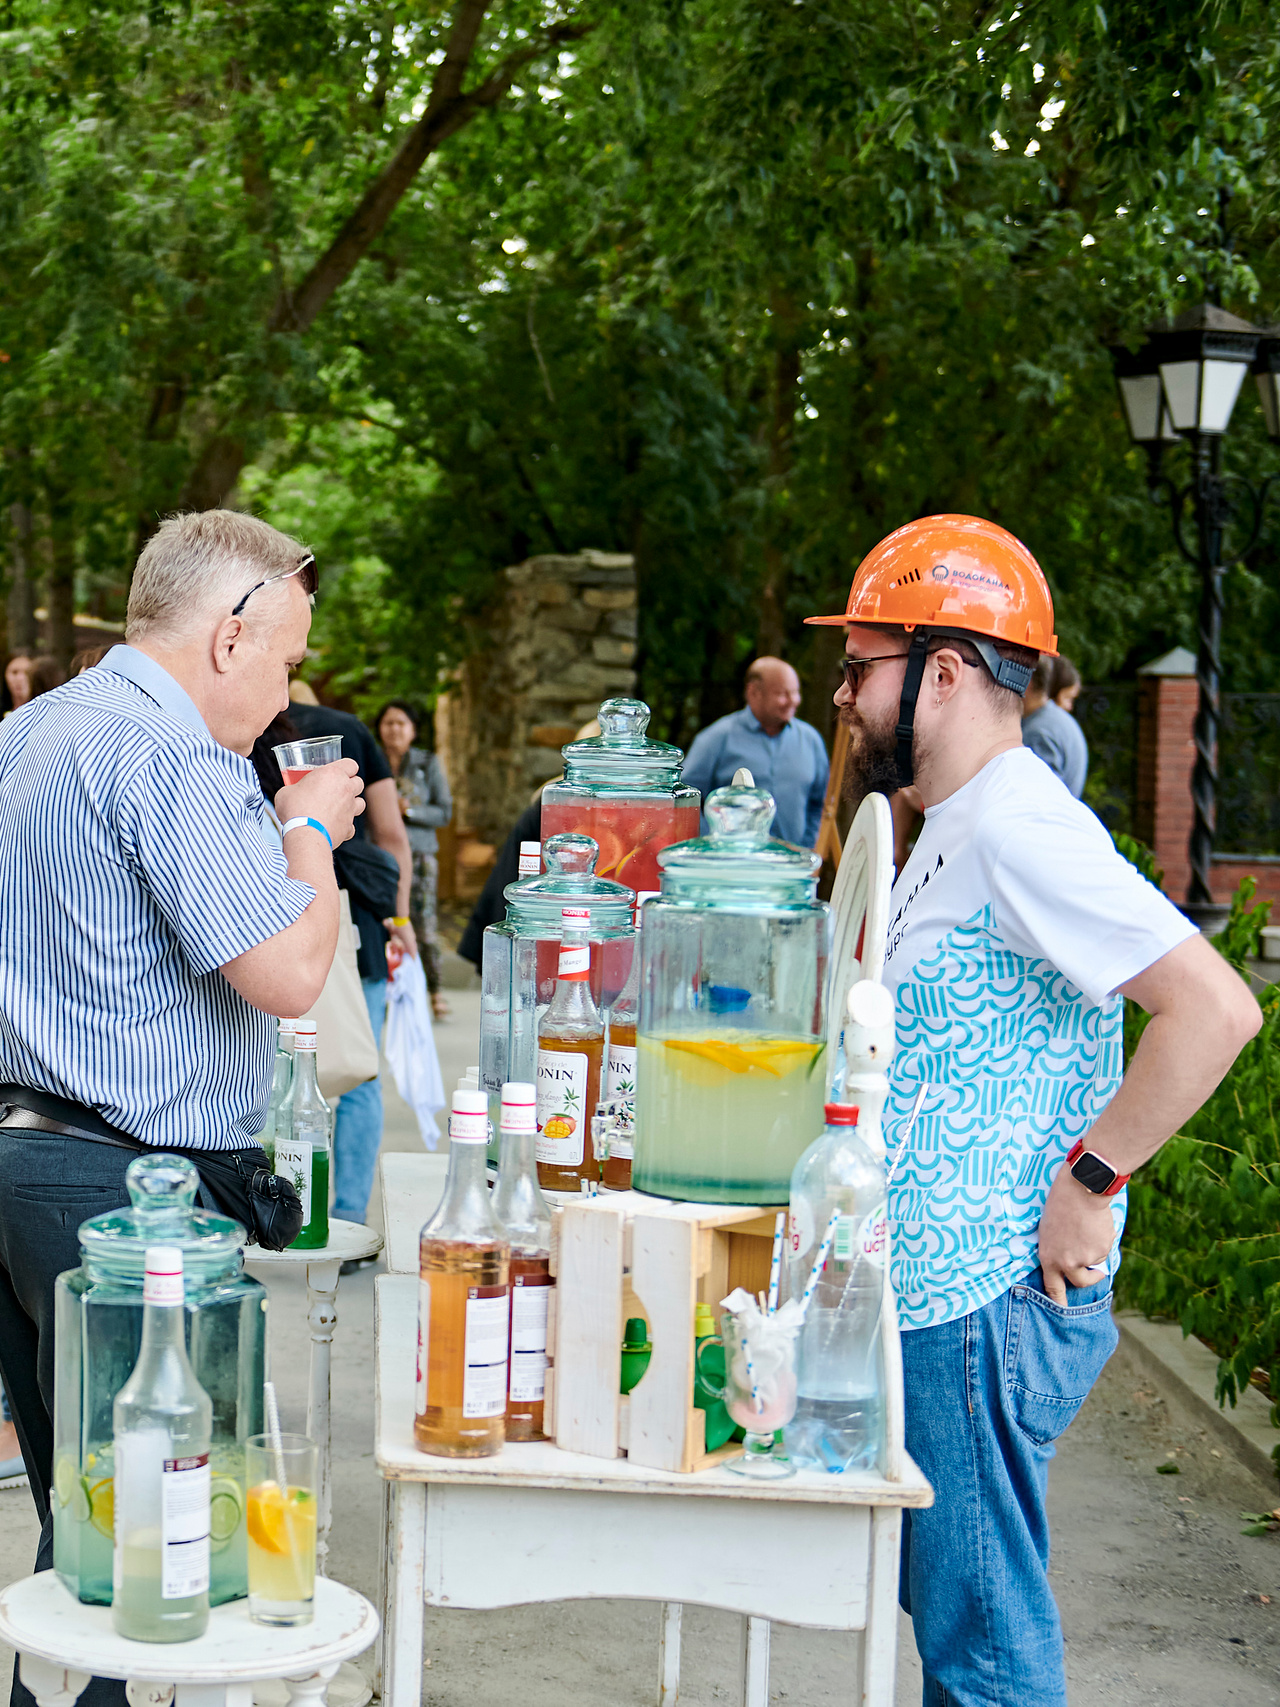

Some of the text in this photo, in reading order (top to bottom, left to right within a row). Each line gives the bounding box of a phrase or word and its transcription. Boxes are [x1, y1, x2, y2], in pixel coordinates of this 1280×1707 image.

[952, 569, 1011, 591] ВОДОКАНАЛ
[537, 1066, 574, 1081] ONIN
[608, 1061, 632, 1074] NIN
[275, 1150, 302, 1163] ONIN
